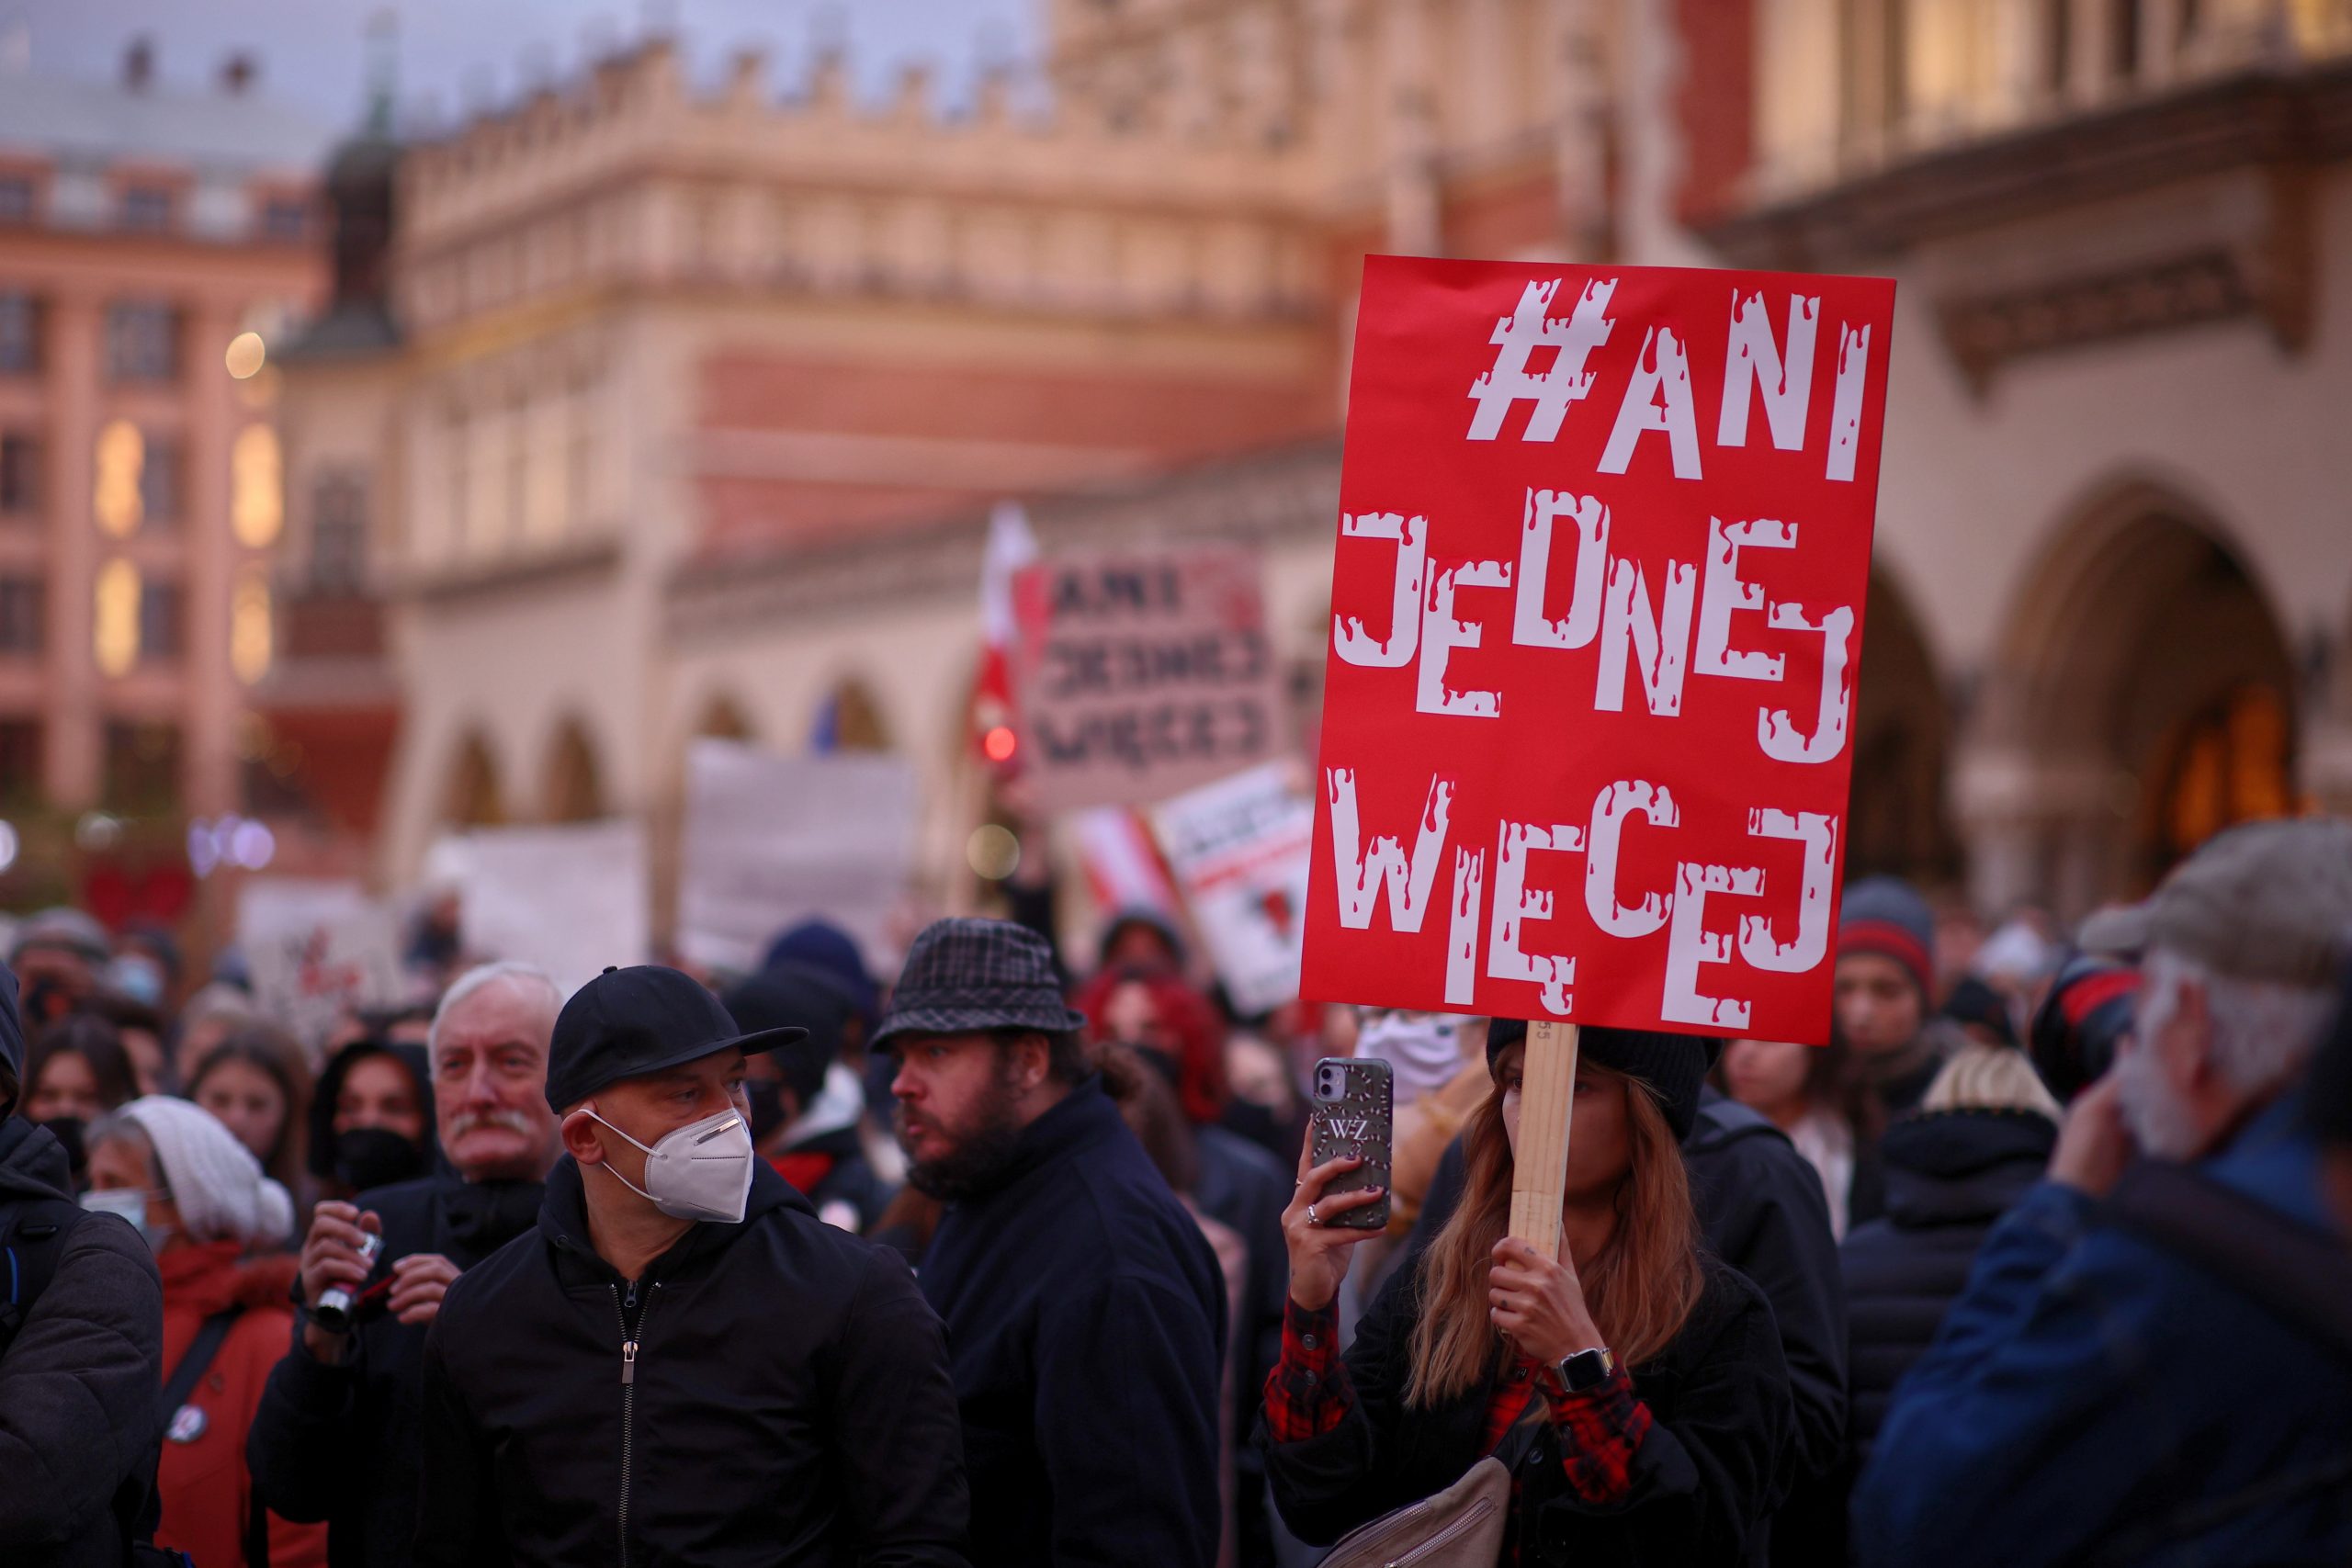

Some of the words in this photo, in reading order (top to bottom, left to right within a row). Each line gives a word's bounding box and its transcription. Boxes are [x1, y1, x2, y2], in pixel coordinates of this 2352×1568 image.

[1466, 277, 1871, 481] #ANI
[1050, 562, 1180, 617] ANI
[1334, 486, 1855, 764] JEDNEJ
[1327, 766, 1838, 1030] WIĘCEJ
[1329, 1118, 1368, 1141] WZ
